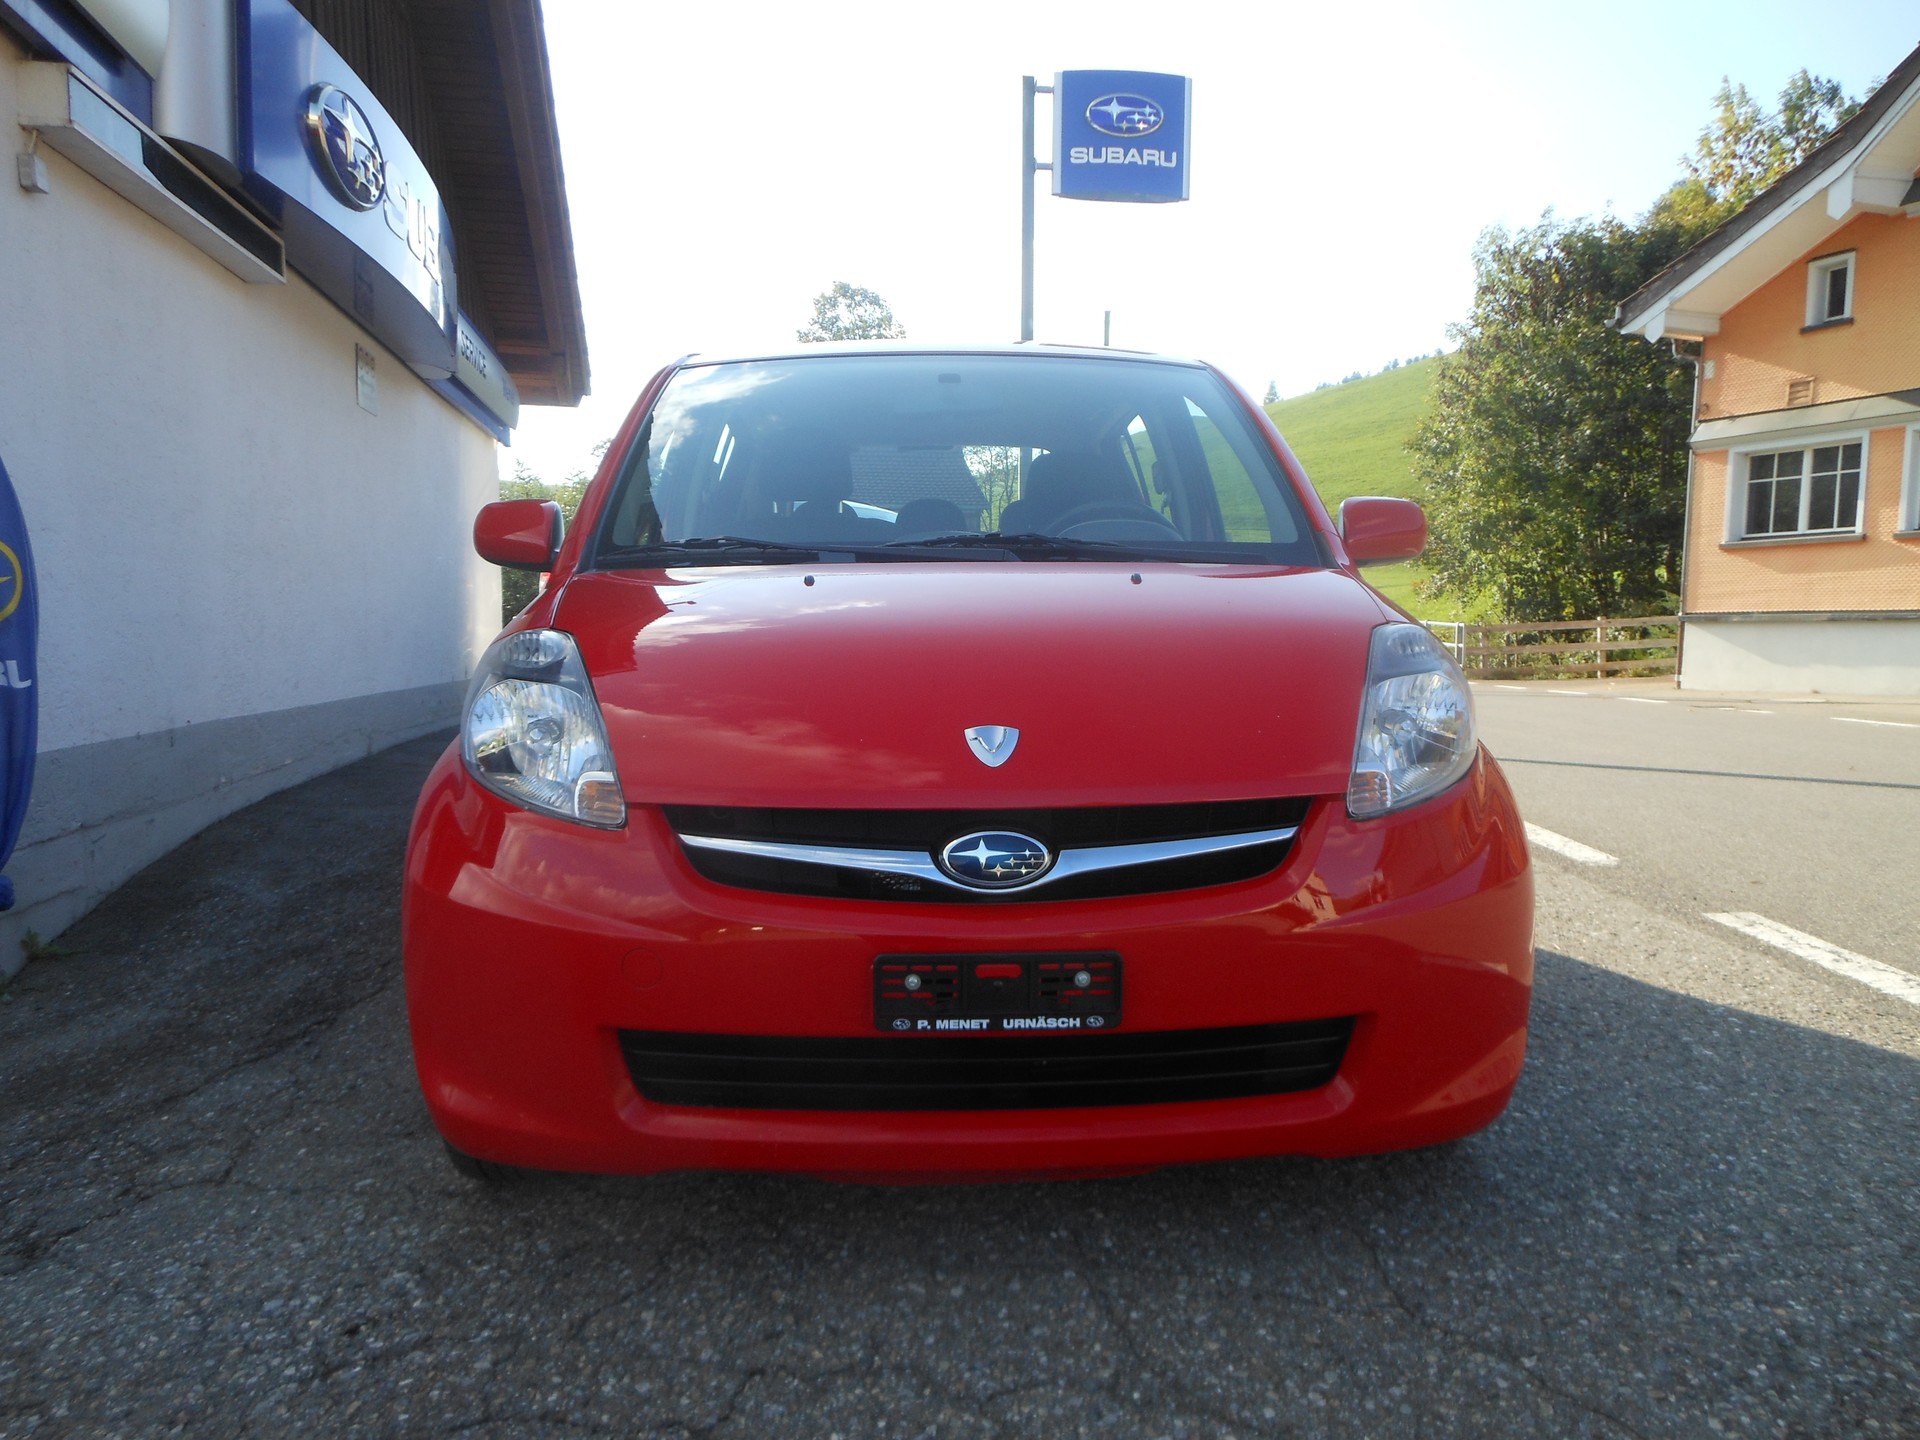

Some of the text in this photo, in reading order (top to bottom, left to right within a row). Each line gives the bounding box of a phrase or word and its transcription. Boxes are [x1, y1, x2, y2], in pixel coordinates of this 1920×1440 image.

[1070, 147, 1177, 168] SUBARU
[461, 330, 487, 379] SERVICE
[917, 1016, 1081, 1030] P. MENET URNÄSCH
